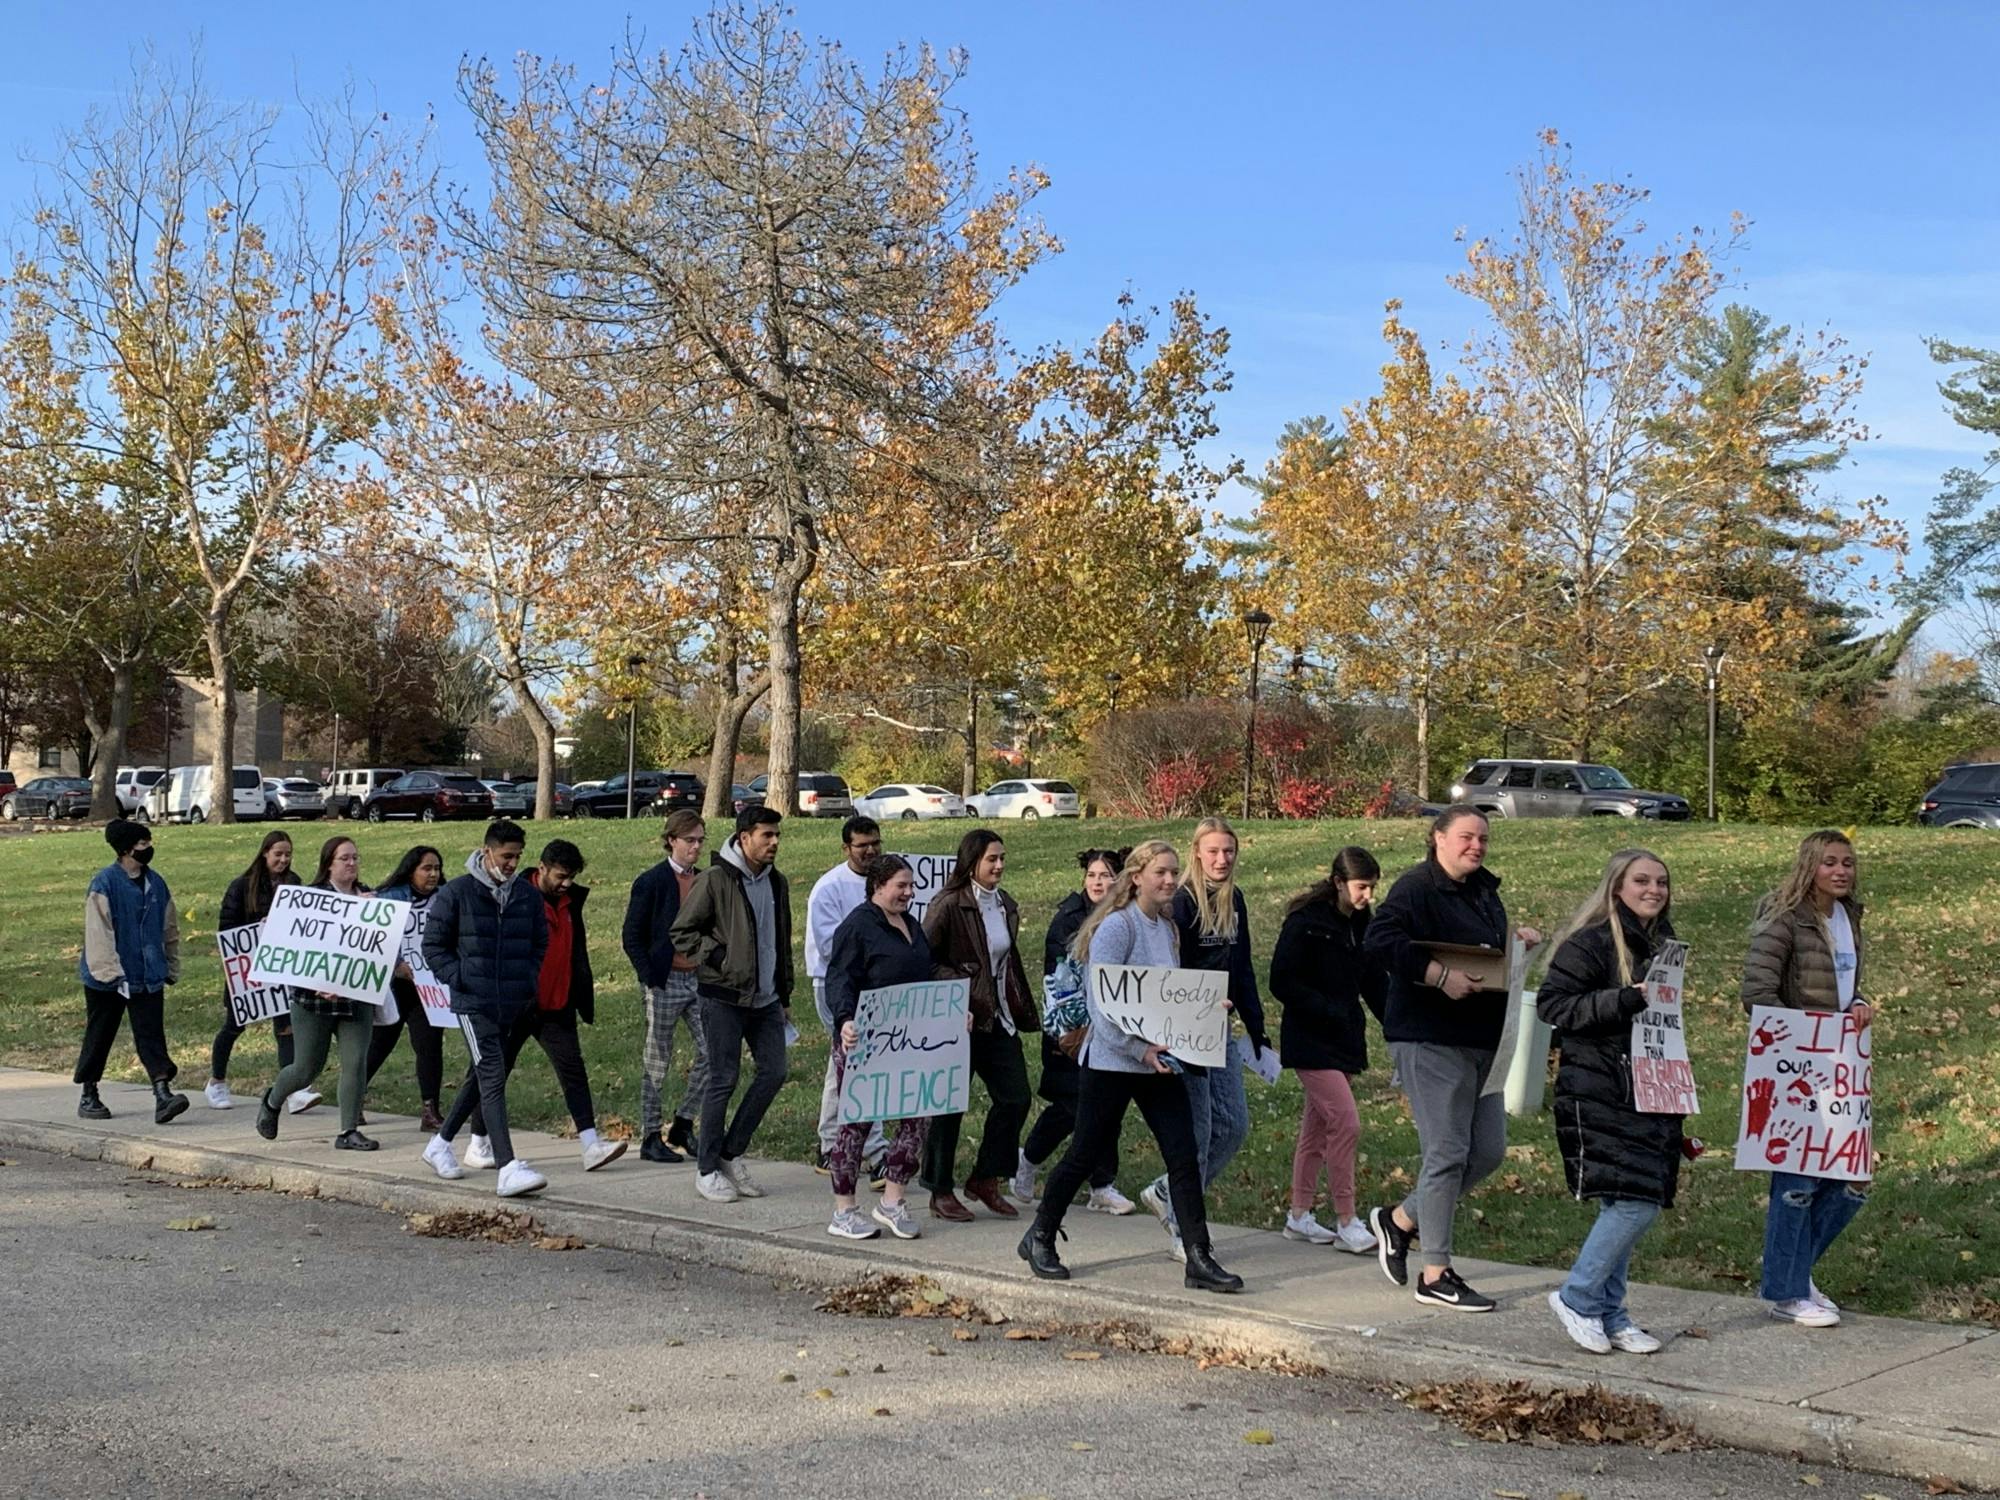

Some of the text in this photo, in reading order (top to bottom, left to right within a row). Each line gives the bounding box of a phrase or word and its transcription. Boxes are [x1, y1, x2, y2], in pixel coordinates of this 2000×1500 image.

[276, 888, 396, 927] PROTECT US
[220, 924, 260, 958] NOT
[289, 917, 387, 955] NOT YOUR
[254, 945, 388, 993] REPUTATION
[233, 988, 266, 1025] BUT
[873, 982, 964, 1028] SHATTER
[1099, 968, 1218, 1020] MY body
[875, 1024, 959, 1056] the
[1155, 1016, 1225, 1052] choice!
[843, 1065, 963, 1123] SILENCE
